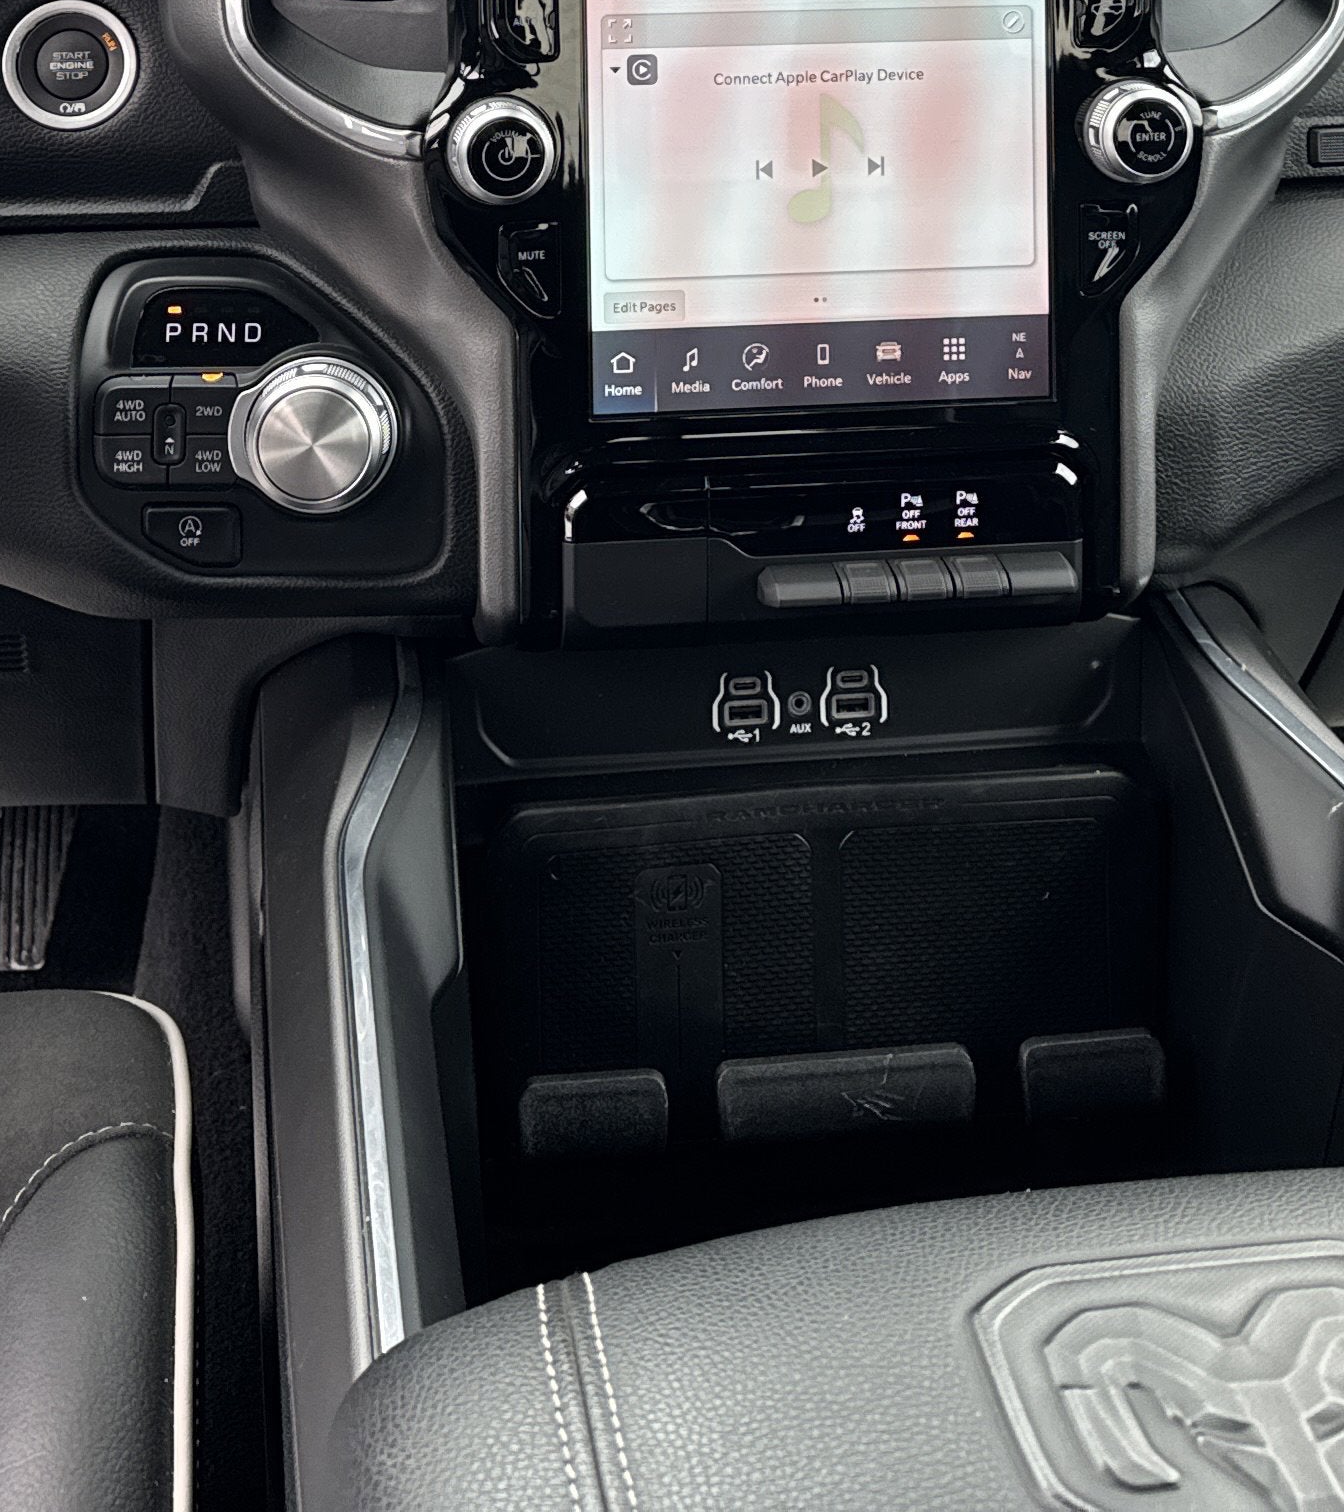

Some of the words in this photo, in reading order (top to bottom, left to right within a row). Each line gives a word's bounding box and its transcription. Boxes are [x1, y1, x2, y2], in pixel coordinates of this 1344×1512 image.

[52, 51, 91, 60] START
[49, 61, 94, 71] ENGINE
[56, 71, 88, 80] STOP
[713, 72, 773, 86] Connect
[775, 70, 817, 87] Apple
[820, 69, 874, 85] CarPlay
[877, 67, 925, 82] Device
[1139, 111, 1163, 120] TUNE
[1136, 131, 1167, 142] ENTER
[1137, 150, 1168, 163] SCROLL
[1088, 231, 1126, 241] SCREEN
[517, 251, 546, 261] MUTE
[612, 301, 638, 314] Edit
[641, 300, 677, 317] Pages
[1011, 332, 1027, 343] NE
[866, 371, 912, 386] Vehicle
[938, 370, 970, 385] Apps
[1008, 366, 1033, 380] Nav
[731, 376, 783, 392] Comfort
[803, 374, 844, 388] Phone
[604, 383, 643, 397] Home
[671, 380, 711, 394] Media
[115, 399, 144, 411] 4WD
[114, 410, 146, 421] AUTO
[195, 406, 223, 417] 2WD
[114, 450, 142, 461] 4WD
[164, 445, 174, 456] N
[195, 450, 222, 461] 4WD
[113, 461, 143, 473] HIGH
[195, 461, 221, 473] LOW
[902, 510, 921, 520] OFF
[957, 507, 976, 517] OFF
[847, 523, 866, 533] OFF
[895, 520, 927, 531] FRONT
[955, 518, 979, 528] REAR
[179, 537, 201, 547] OFF
[789, 722, 812, 734] AUX
[861, 721, 871, 736] 2
[753, 728, 760, 743] 1
